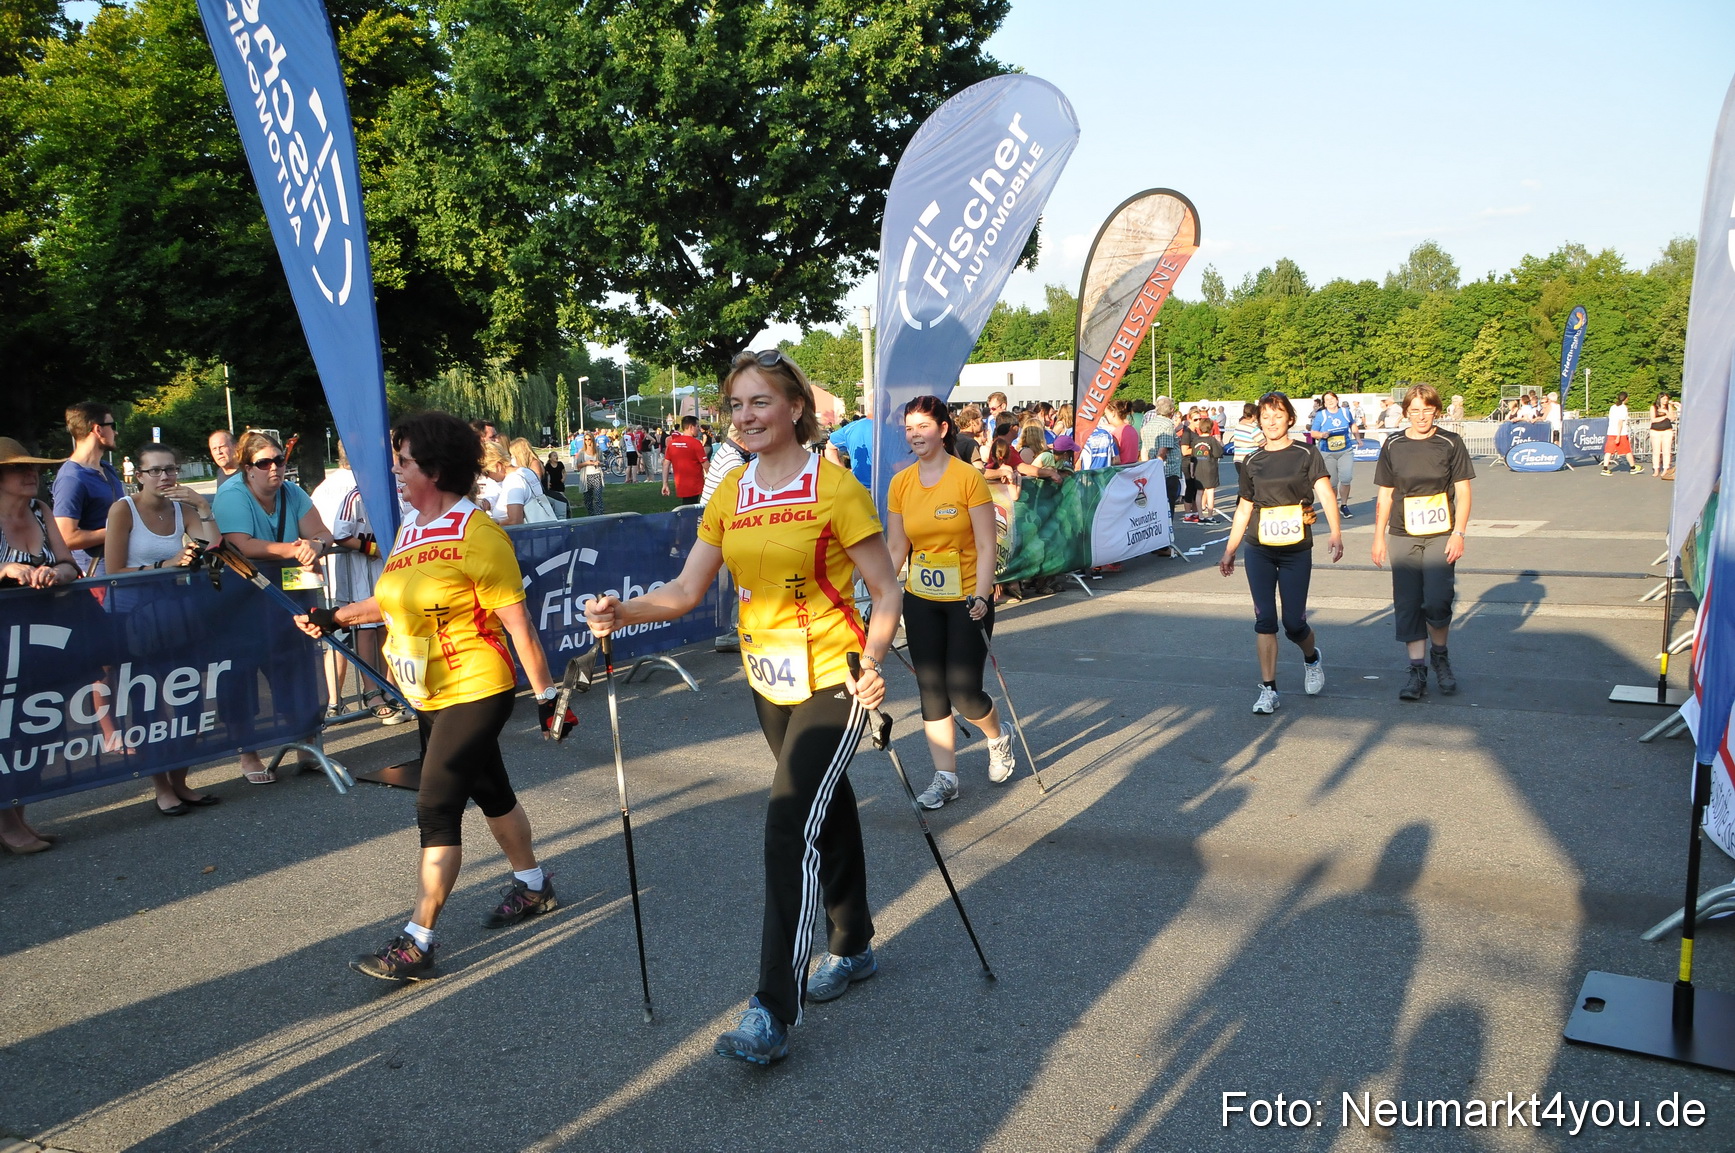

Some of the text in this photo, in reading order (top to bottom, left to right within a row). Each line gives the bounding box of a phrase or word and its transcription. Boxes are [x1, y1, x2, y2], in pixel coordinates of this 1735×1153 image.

[923, 111, 1029, 299] Fischer
[963, 141, 1044, 294] AUTOMOBILE
[1580, 434, 1605, 445] Fischer
[1521, 454, 1558, 462] Fischer
[728, 514, 764, 531] MAX
[769, 508, 817, 525] BÖGL
[1260, 519, 1301, 537] 1083
[1408, 507, 1447, 526] 1120
[383, 546, 463, 574] MAX BÖGL
[920, 568, 945, 588] 60
[540, 576, 676, 630] Fish
[747, 654, 796, 687] 804
[0, 660, 232, 740] ischer
